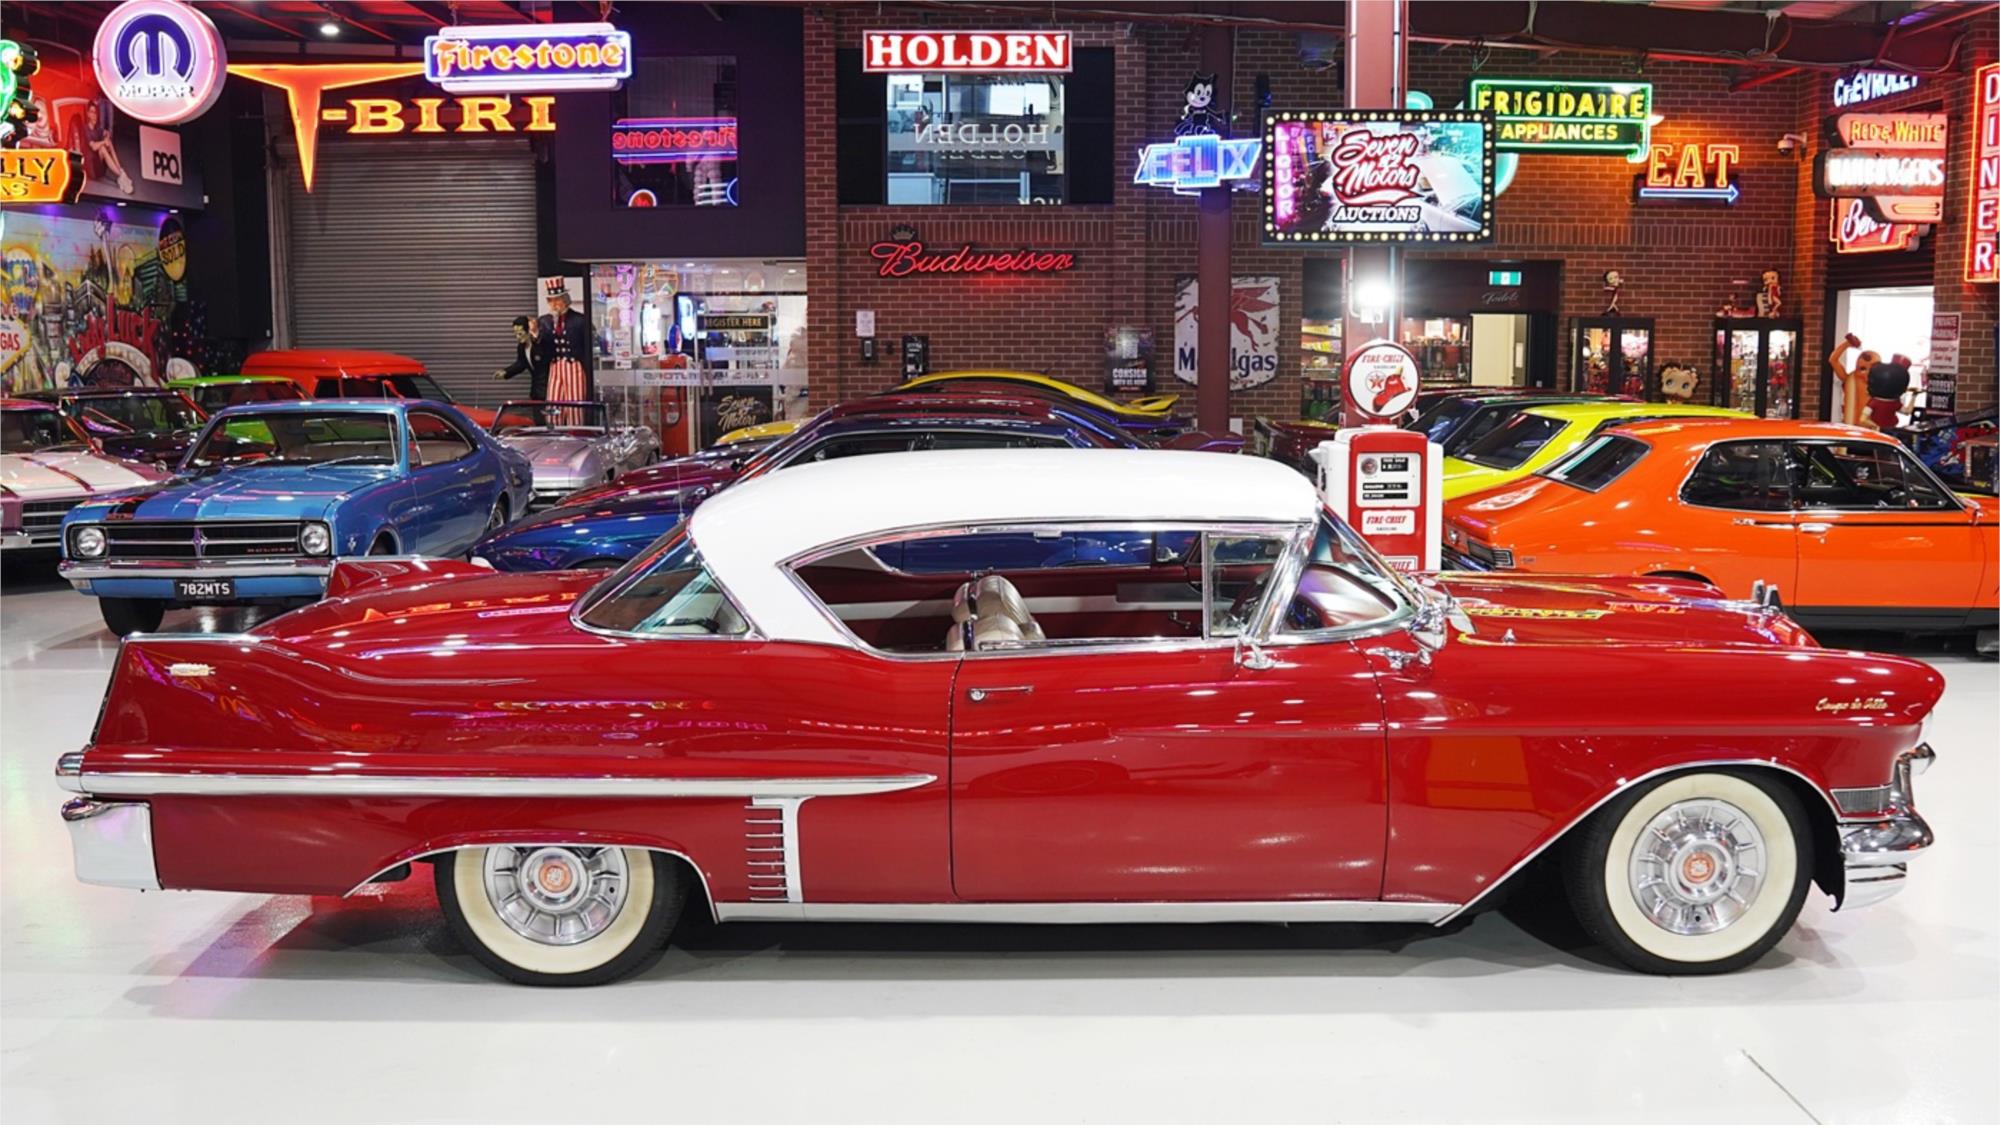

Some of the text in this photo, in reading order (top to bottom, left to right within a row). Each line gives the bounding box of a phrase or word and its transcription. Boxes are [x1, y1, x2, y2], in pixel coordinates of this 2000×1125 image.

[432, 38, 624, 76] Firestone
[869, 34, 1066, 67] HOLDEN
[118, 85, 196, 98] MOPAR
[1477, 90, 1645, 118] FRIGIDAIRE
[1500, 124, 1618, 140] APPLIANCES
[1850, 120, 1943, 143] RED & WHITE
[1150, 143, 1251, 178] FELIX
[1335, 131, 1414, 164] Seven
[153, 150, 181, 180] PPQ
[1275, 126, 1294, 218] LIQUOR
[1340, 162, 1418, 194] Motors
[1647, 144, 1740, 187] EAT
[1829, 158, 1944, 187] HAMBURGERS
[1974, 74, 2000, 272] DINER
[1334, 207, 1419, 222] AUCTIONS
[870, 241, 1074, 277] Budweiser
[704, 317, 762, 328] REGISTER HERE
[1112, 367, 1148, 379] CONSIGN
[1178, 346, 1276, 378] Mlgas
[179, 582, 231, 596] 782MTS
[1815, 697, 1849, 714] Coupe
